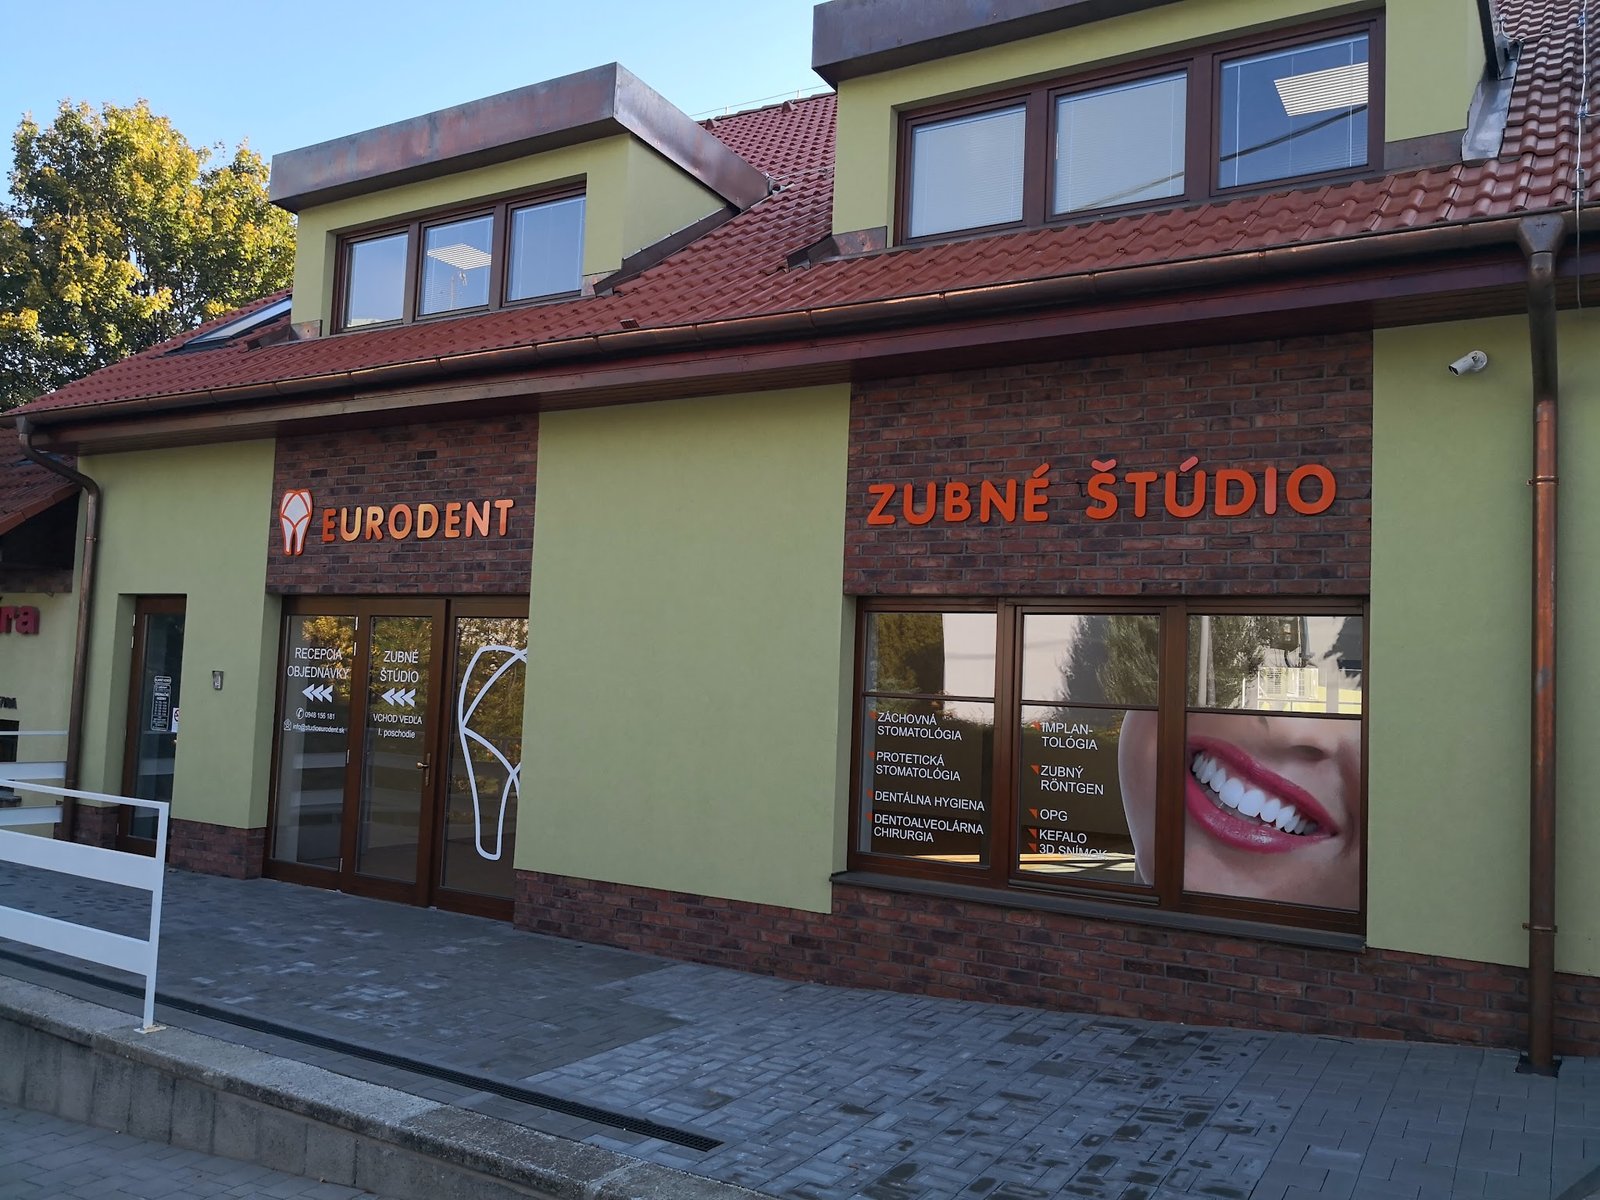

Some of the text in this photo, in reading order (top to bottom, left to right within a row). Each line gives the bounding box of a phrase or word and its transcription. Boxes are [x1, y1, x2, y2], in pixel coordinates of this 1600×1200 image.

[866, 455, 1338, 525] ZUBNÉ ŠTÚDIO
[321, 499, 515, 542] EURODENT
[294, 647, 343, 660] RECEPCIA
[383, 649, 419, 664] ZUBNÉ
[287, 664, 349, 680] OBJEDNÁVKY
[380, 667, 419, 683] ŠTÚDIO
[373, 713, 422, 725] VCHOD VEDĽA
[877, 711, 937, 726] ZÁCHOVNÁ
[383, 729, 416, 739] poschodie
[877, 725, 962, 741] STOMATOLÓGIA
[1041, 722, 1094, 735] IMPLAN-
[1041, 735, 1098, 751] TOLÓGIA
[876, 751, 945, 767] PROTETICKÁ
[875, 765, 961, 782] STOMATOLÓGIA
[1040, 764, 1084, 779] ZUBNÝ
[1040, 779, 1105, 796] RÖNTGEN
[874, 790, 985, 812] DENTÁLNA HYGIENA
[1040, 808, 1068, 821] OPG
[874, 813, 984, 835] DENTOALVEOLÁRNA
[873, 826, 934, 843] CHIRURGIA
[1039, 829, 1087, 844] KEFALO
[1039, 843, 1055, 855] 3D
